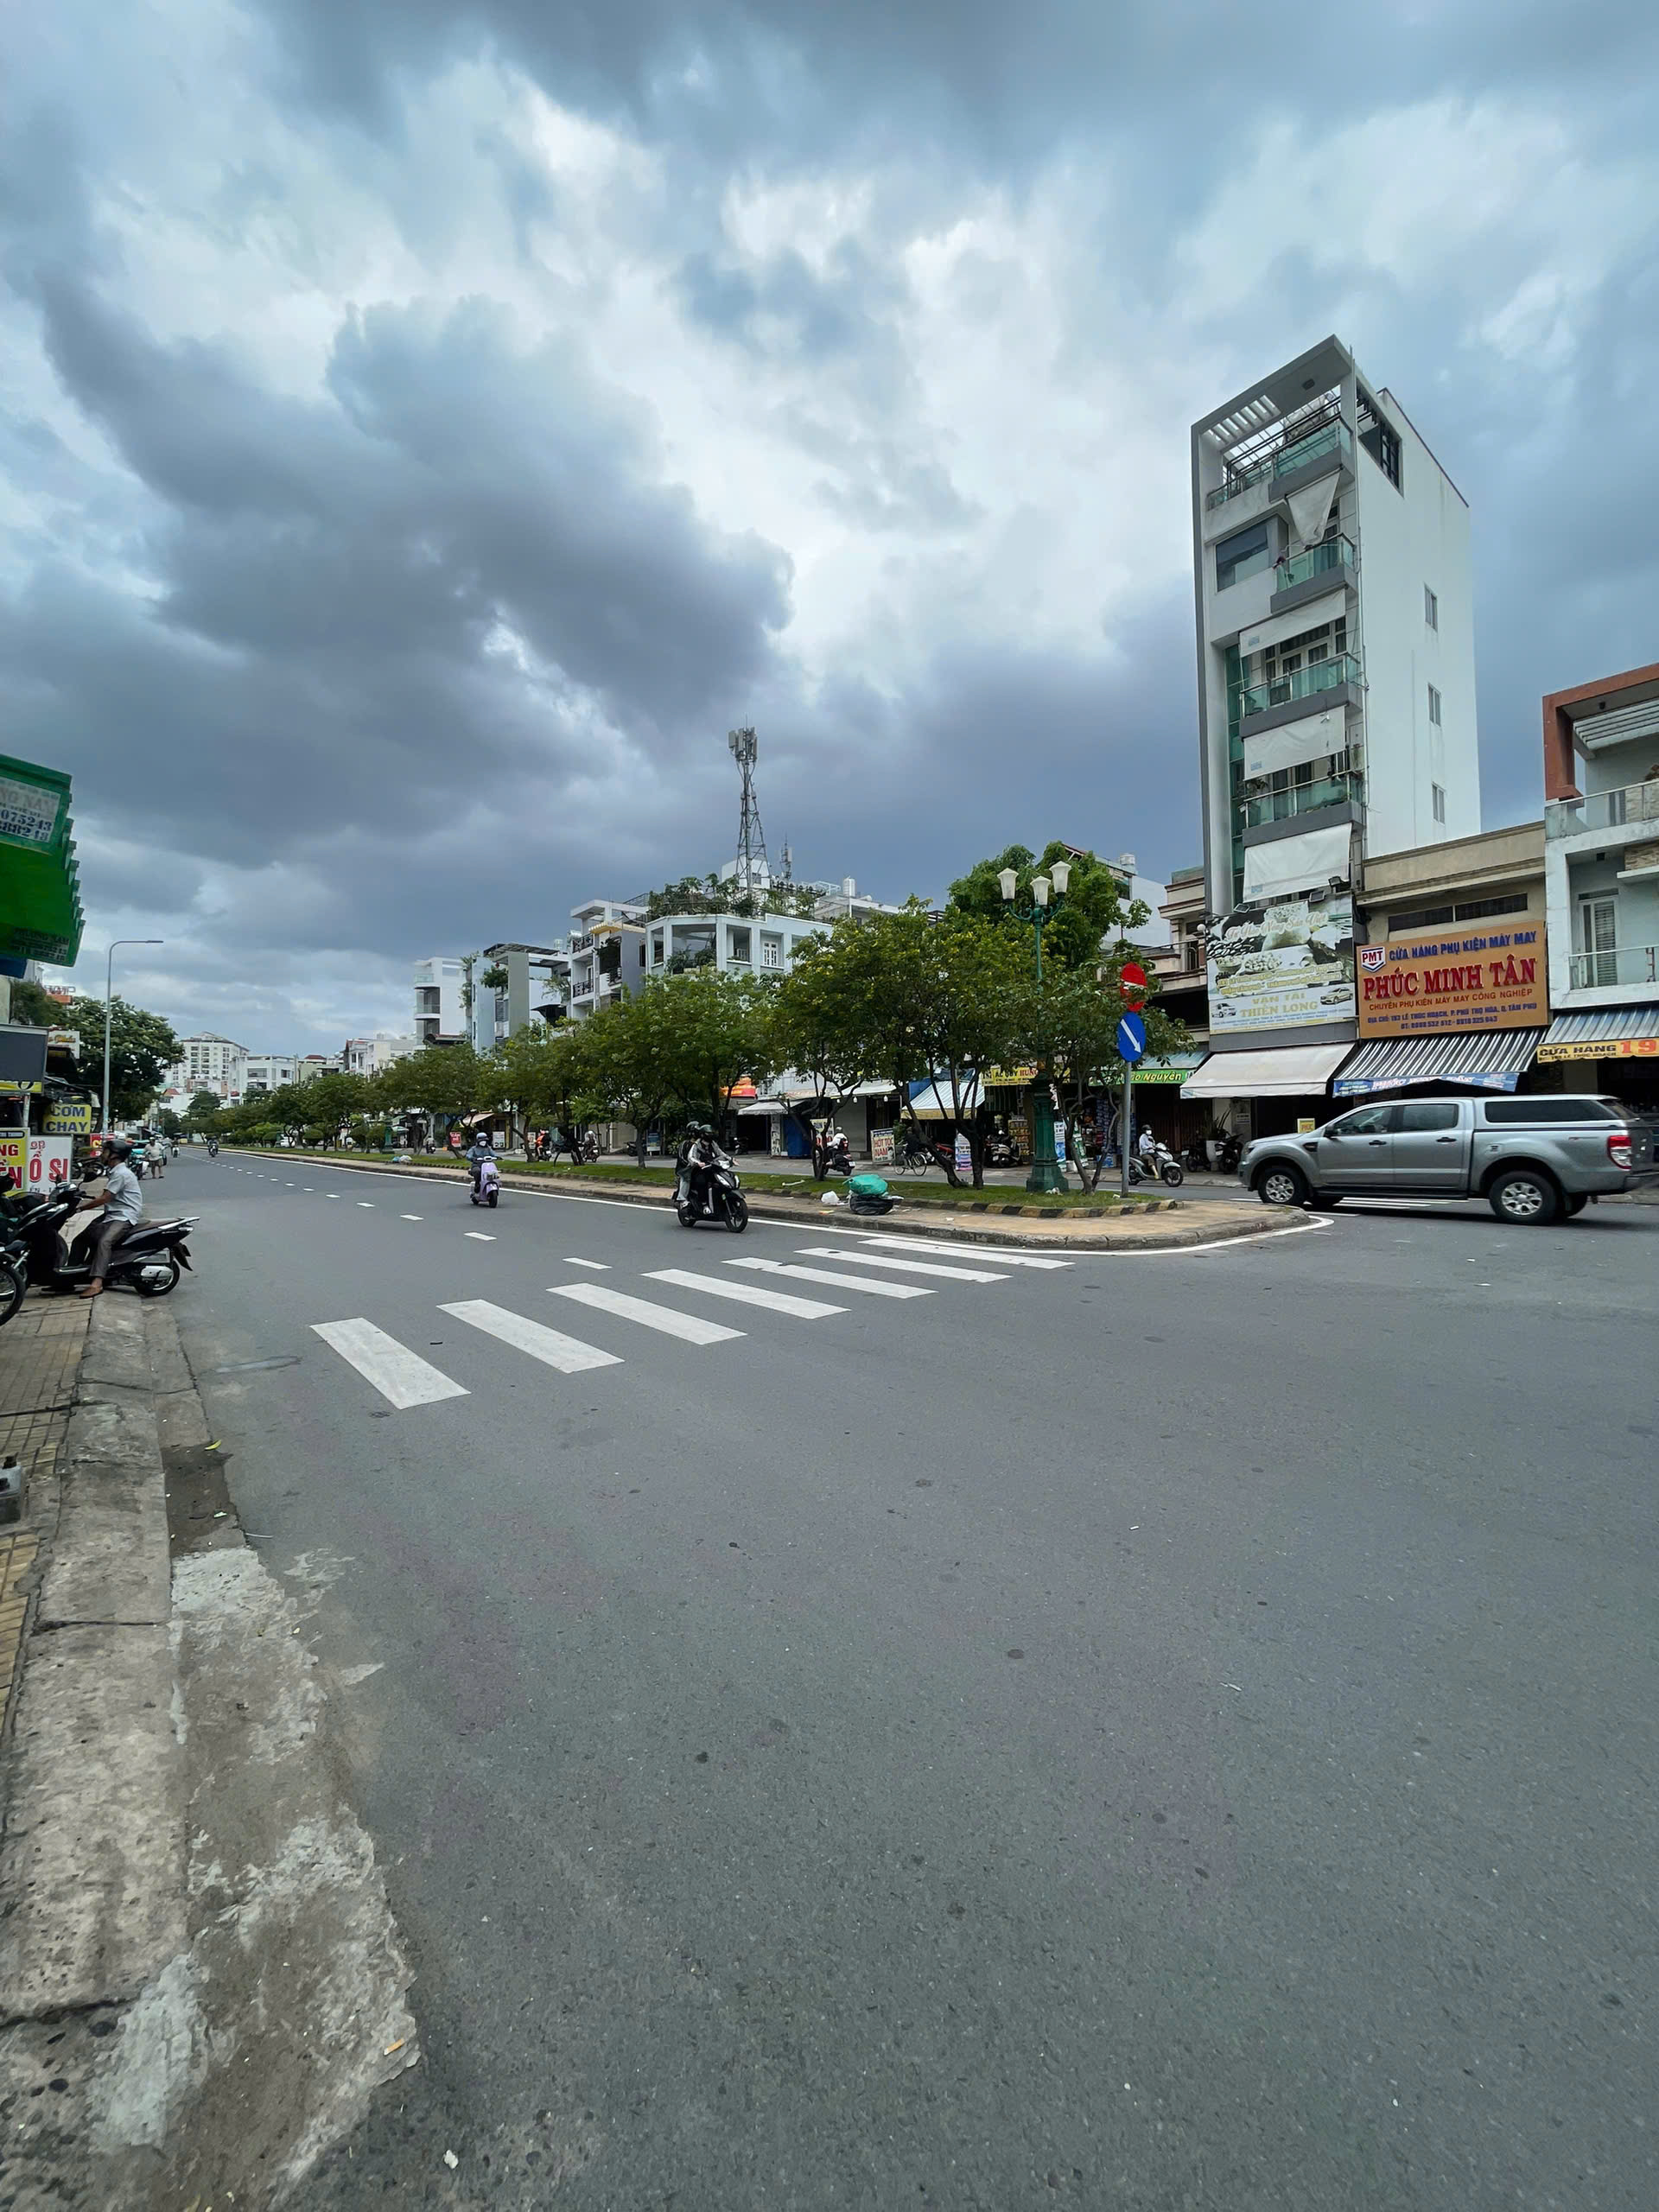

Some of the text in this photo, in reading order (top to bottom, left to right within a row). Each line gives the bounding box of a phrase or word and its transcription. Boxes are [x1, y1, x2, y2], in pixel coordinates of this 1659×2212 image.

[1440, 943, 1460, 956] PHỤ
[1463, 937, 1486, 952] KIỆN
[1514, 931, 1536, 944] MAY
[1362, 950, 1383, 963] PMT
[1363, 953, 1537, 1001] PHÚC MINH TÂN
[1283, 1001, 1319, 1014] LONG
[1369, 1001, 1398, 1011] CHUYÊN
[1399, 1000, 1414, 1009] PHỤ
[1472, 991, 1496, 1001] CÔNG
[1508, 1003, 1521, 1012] TÂN
[1143, 1071, 1182, 1083] Nguyên
[52, 1106, 86, 1117] CƠM
[46, 1121, 88, 1133] CHAY
